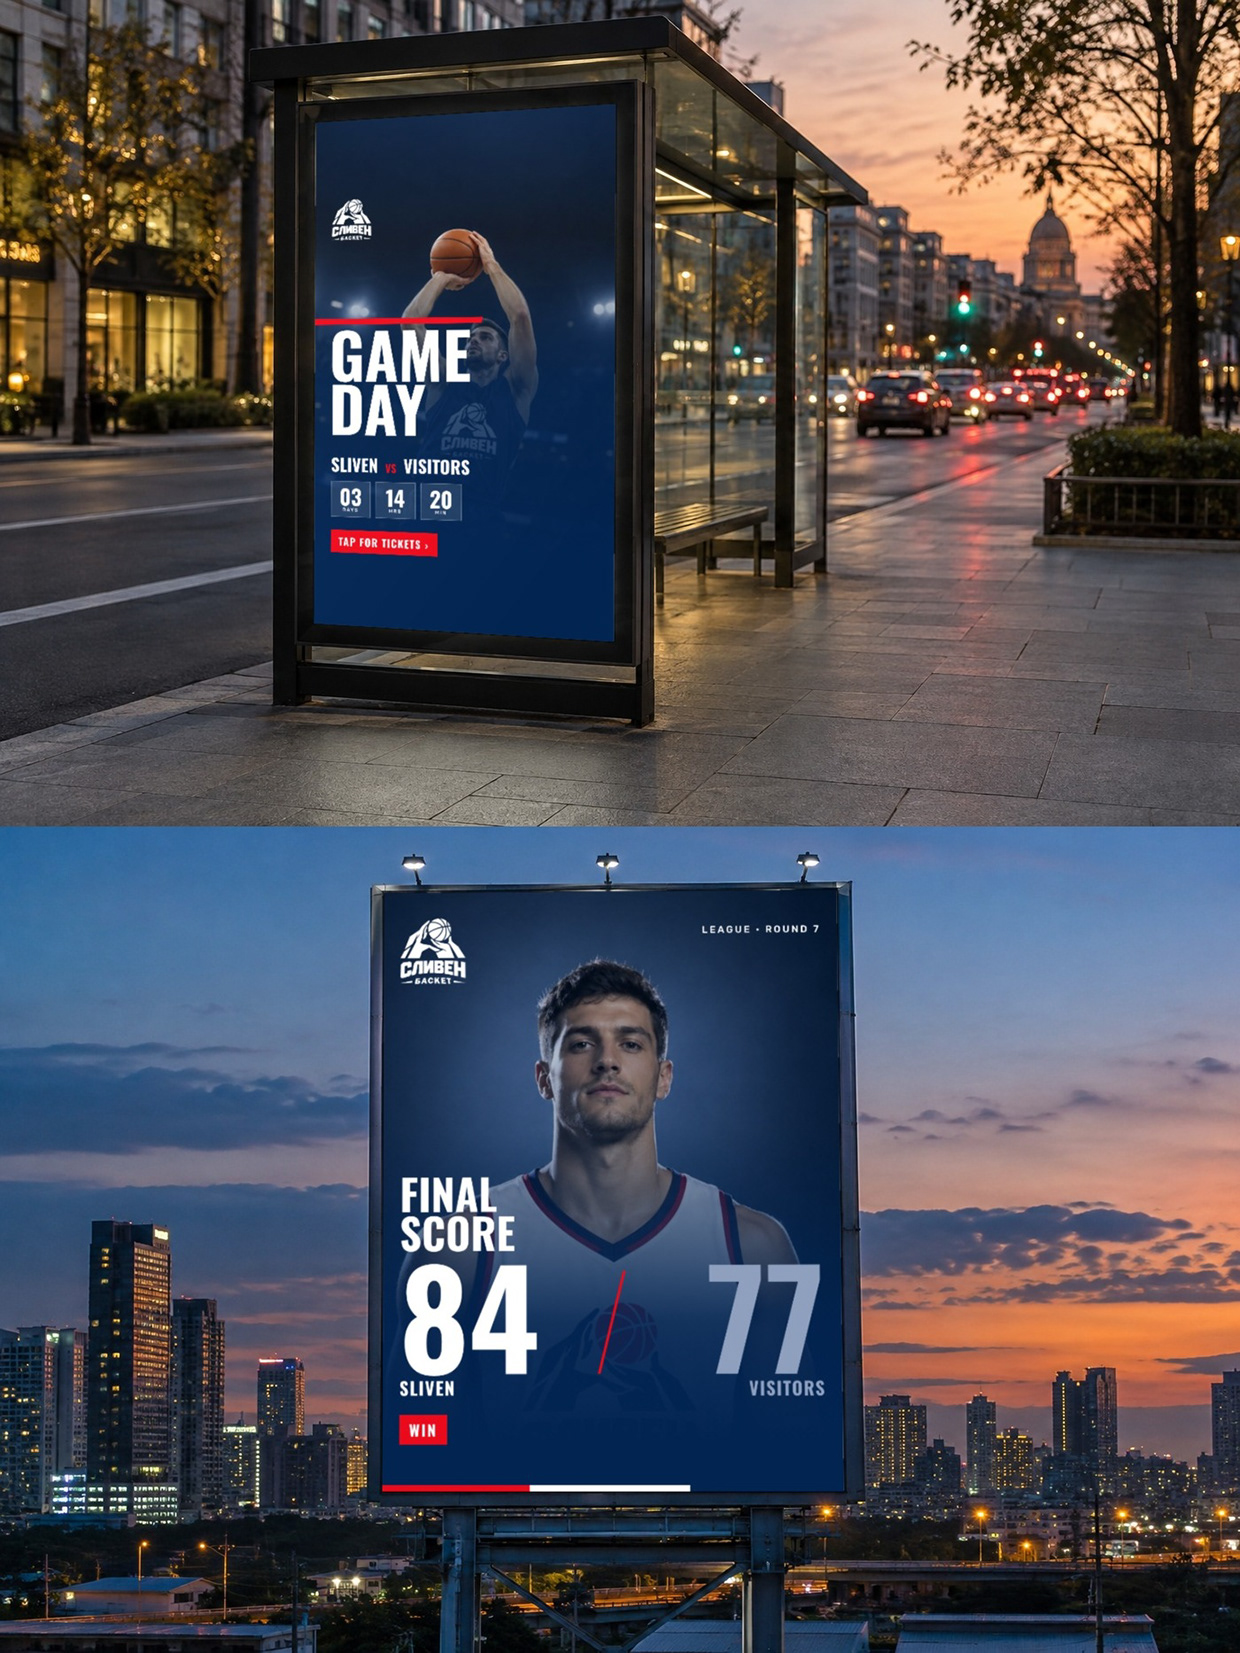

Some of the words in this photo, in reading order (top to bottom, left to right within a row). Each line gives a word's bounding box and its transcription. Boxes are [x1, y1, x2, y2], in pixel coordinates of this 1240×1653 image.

[332, 225, 371, 237] СЛИВЕН
[332, 329, 471, 382] GAME
[332, 384, 426, 437] DAY
[441, 436, 497, 455] СЛИВЕН
[331, 457, 378, 473] SLIVEN
[385, 463, 397, 474] VS
[403, 459, 470, 476] VISITORS
[340, 488, 362, 507] 03
[385, 489, 405, 508] 14
[429, 490, 452, 510] 20
[338, 537, 356, 547] TAP
[359, 538, 378, 548] FOR
[381, 538, 421, 550] TICKETS
[702, 925, 750, 934] LEAGUE
[765, 924, 807, 934] ROUND
[813, 924, 820, 933] 7
[400, 960, 466, 978] СЛИВЕН
[414, 977, 452, 985] БАСКЕТ
[401, 1177, 497, 1213] FINAL
[400, 1216, 515, 1252] SCORE
[404, 1263, 537, 1377] 84
[708, 1264, 821, 1375] 77
[399, 1381, 454, 1397] SLIVEN
[749, 1380, 825, 1397] VISITORS
[409, 1424, 436, 1438] WIN
